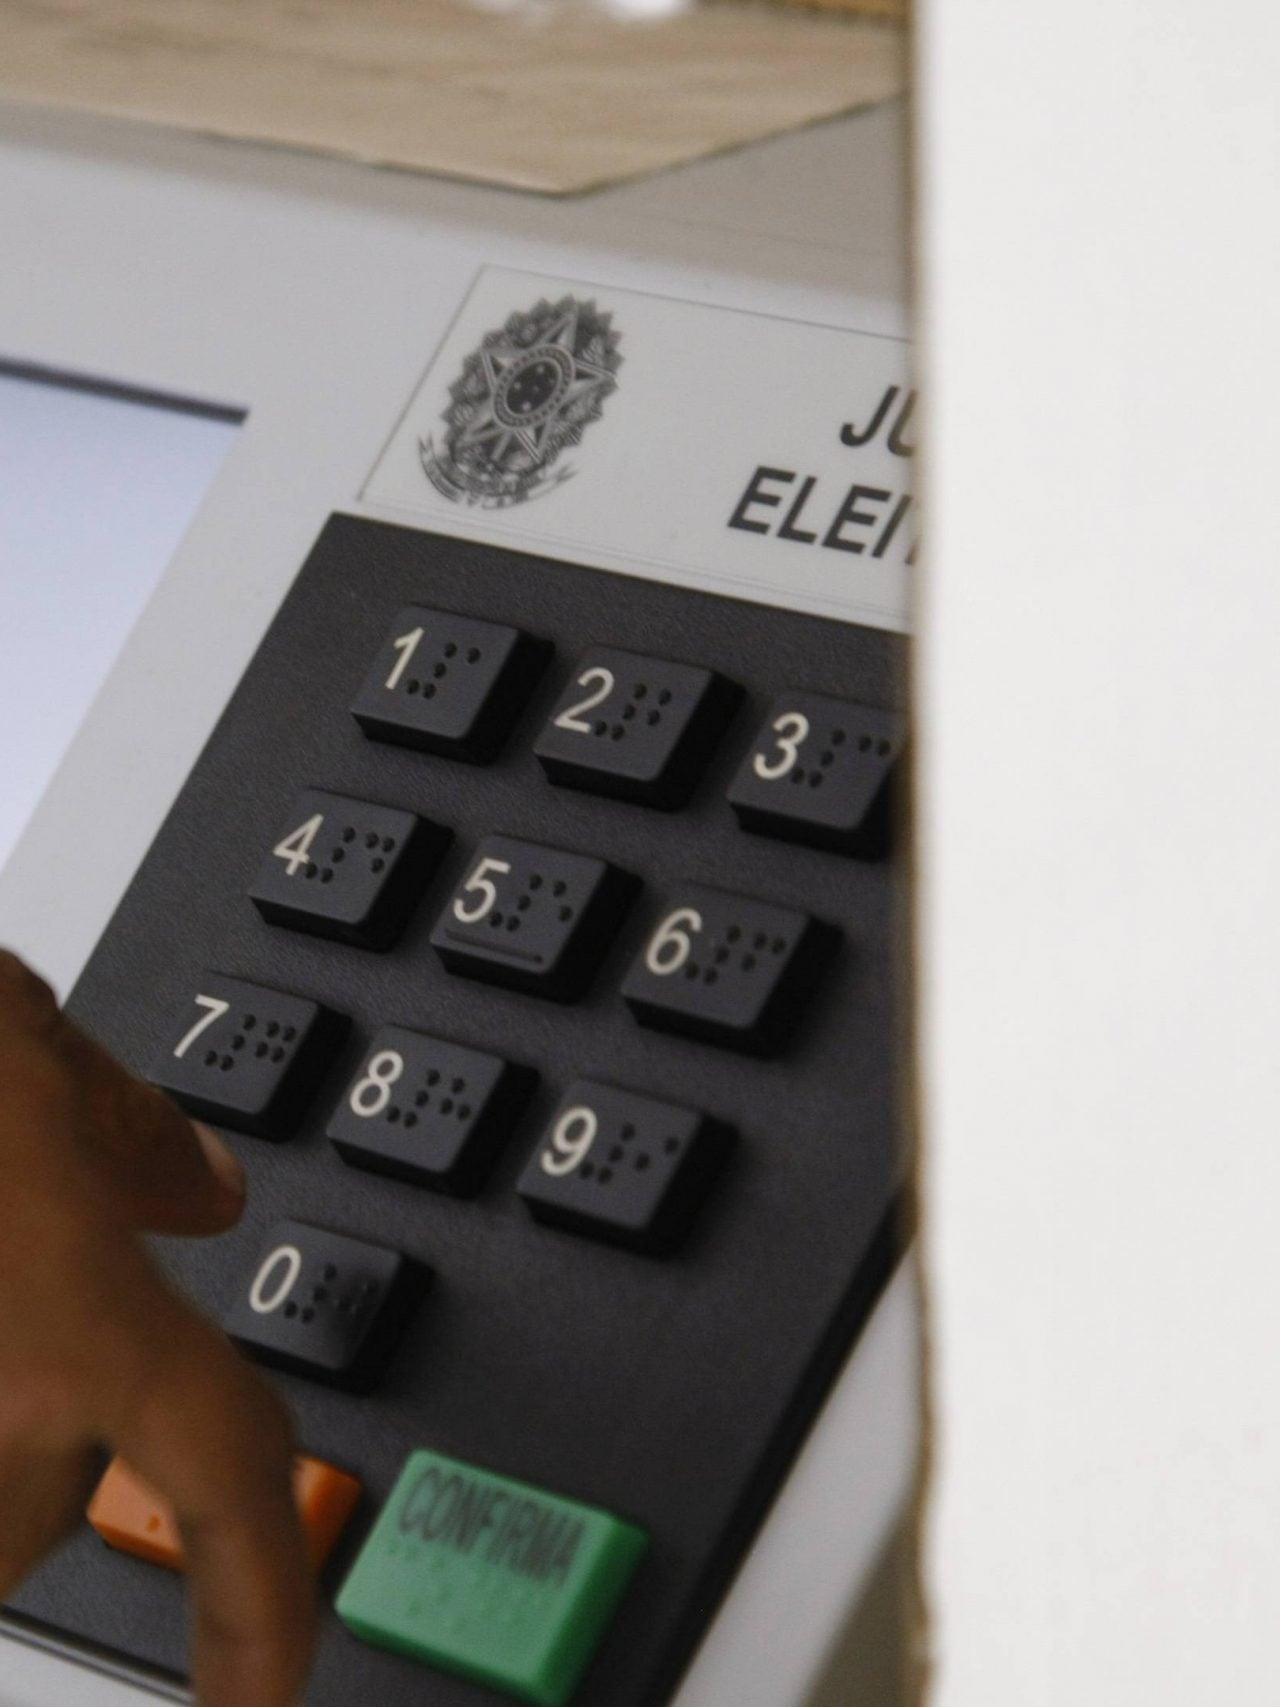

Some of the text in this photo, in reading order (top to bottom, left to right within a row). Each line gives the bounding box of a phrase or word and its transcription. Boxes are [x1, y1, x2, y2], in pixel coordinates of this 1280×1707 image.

[727, 465, 916, 566] ELEI
[385, 627, 424, 690] 1
[554, 667, 615, 733] 2
[753, 712, 809, 780] 3
[273, 813, 324, 876] 4
[453, 857, 511, 923] 5
[646, 908, 702, 975] 6
[173, 993, 230, 1058] 7
[349, 1050, 404, 1118] 8
[541, 1107, 598, 1176] 9
[249, 1245, 302, 1314] 0
[399, 1466, 586, 1587] CONFIRMA
